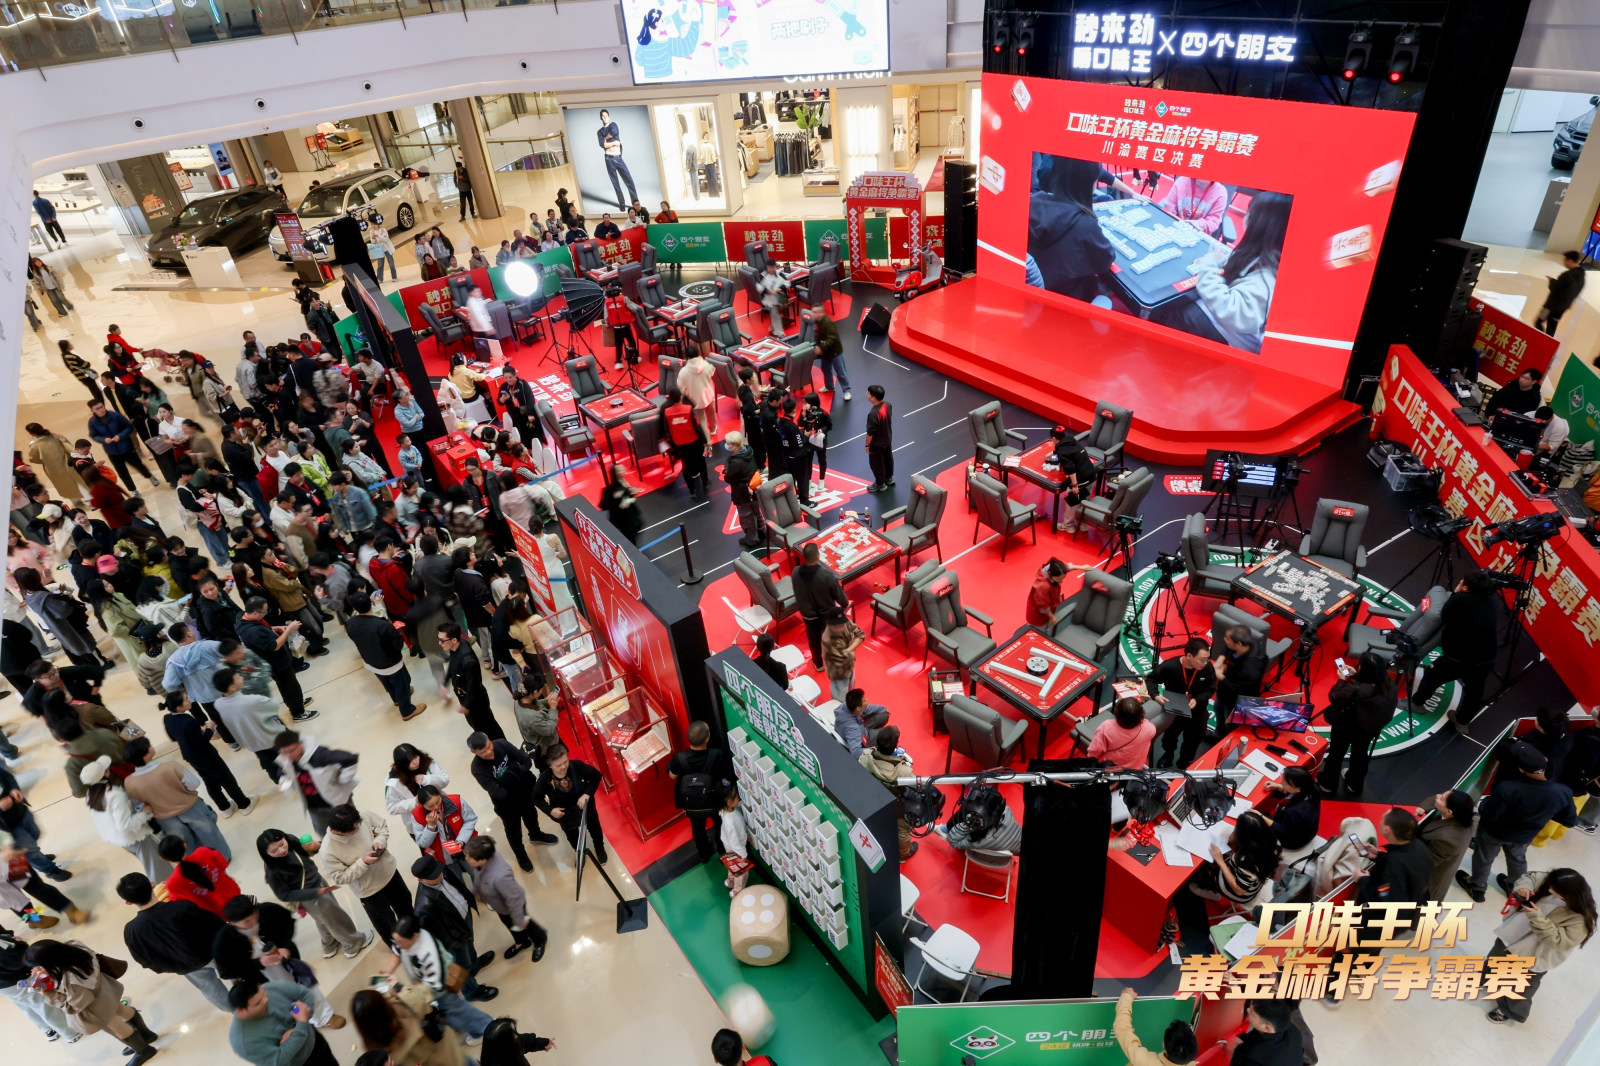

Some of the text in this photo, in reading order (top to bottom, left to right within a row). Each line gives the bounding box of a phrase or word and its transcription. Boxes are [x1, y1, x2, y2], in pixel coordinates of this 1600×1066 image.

[1074, 13, 1155, 46] 秒来劲
[1181, 32, 1297, 62] 四个朋友
[1065, 112, 1259, 156] 口味王杯黄金麻将争霸赛
[1102, 140, 1205, 168] 川渝赛区决赛
[849, 187, 919, 199] 黄金麻将争霸赛
[862, 175, 906, 188] 口味王杯
[744, 229, 784, 242] 秒来劲
[1480, 320, 1527, 360] 秒来劲
[725, 666, 795, 736] 四个朋友
[749, 702, 818, 778] 摇骰夺宝
